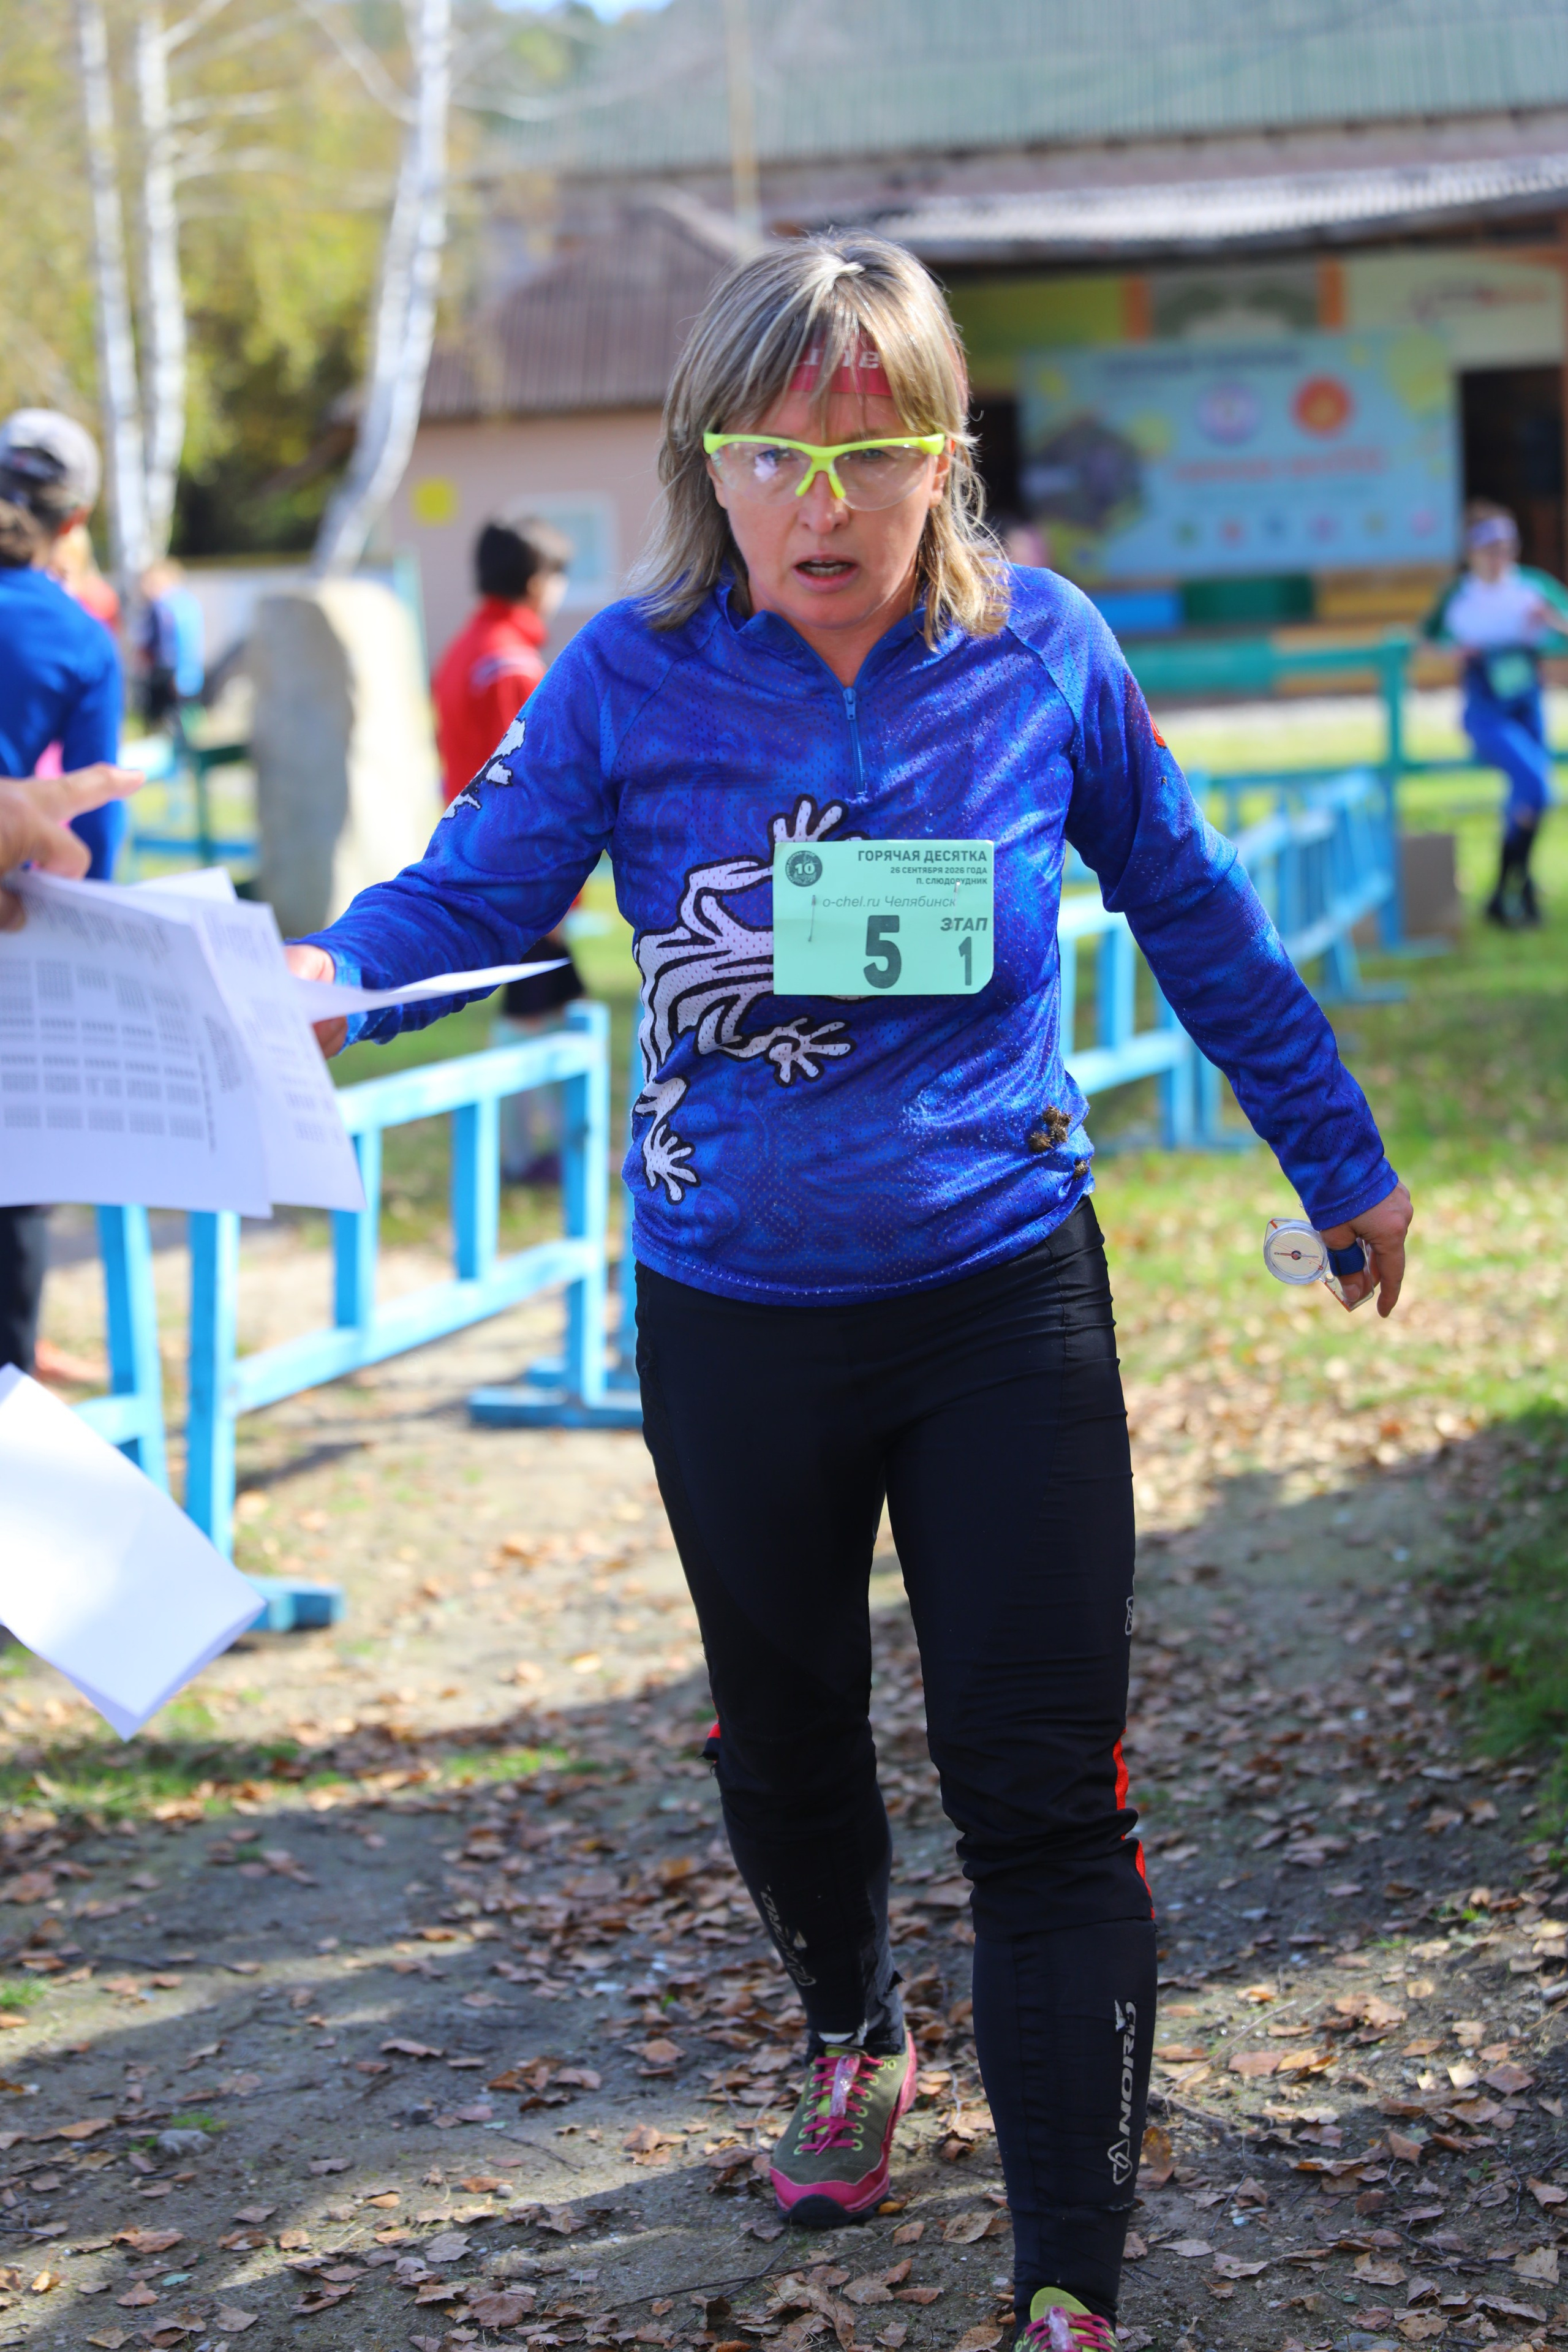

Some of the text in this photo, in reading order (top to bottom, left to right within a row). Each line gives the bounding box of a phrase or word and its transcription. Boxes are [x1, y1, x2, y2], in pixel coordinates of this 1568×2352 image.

[859, 850, 987, 863] ГОРЯЧАЯ ДЕСЯТКА
[794, 863, 815, 875] 10
[823, 896, 956, 907] o-chel.ru Челябинск
[940, 918, 987, 931] ЭТАП
[864, 915, 902, 989] 5
[959, 937, 971, 986] 1
